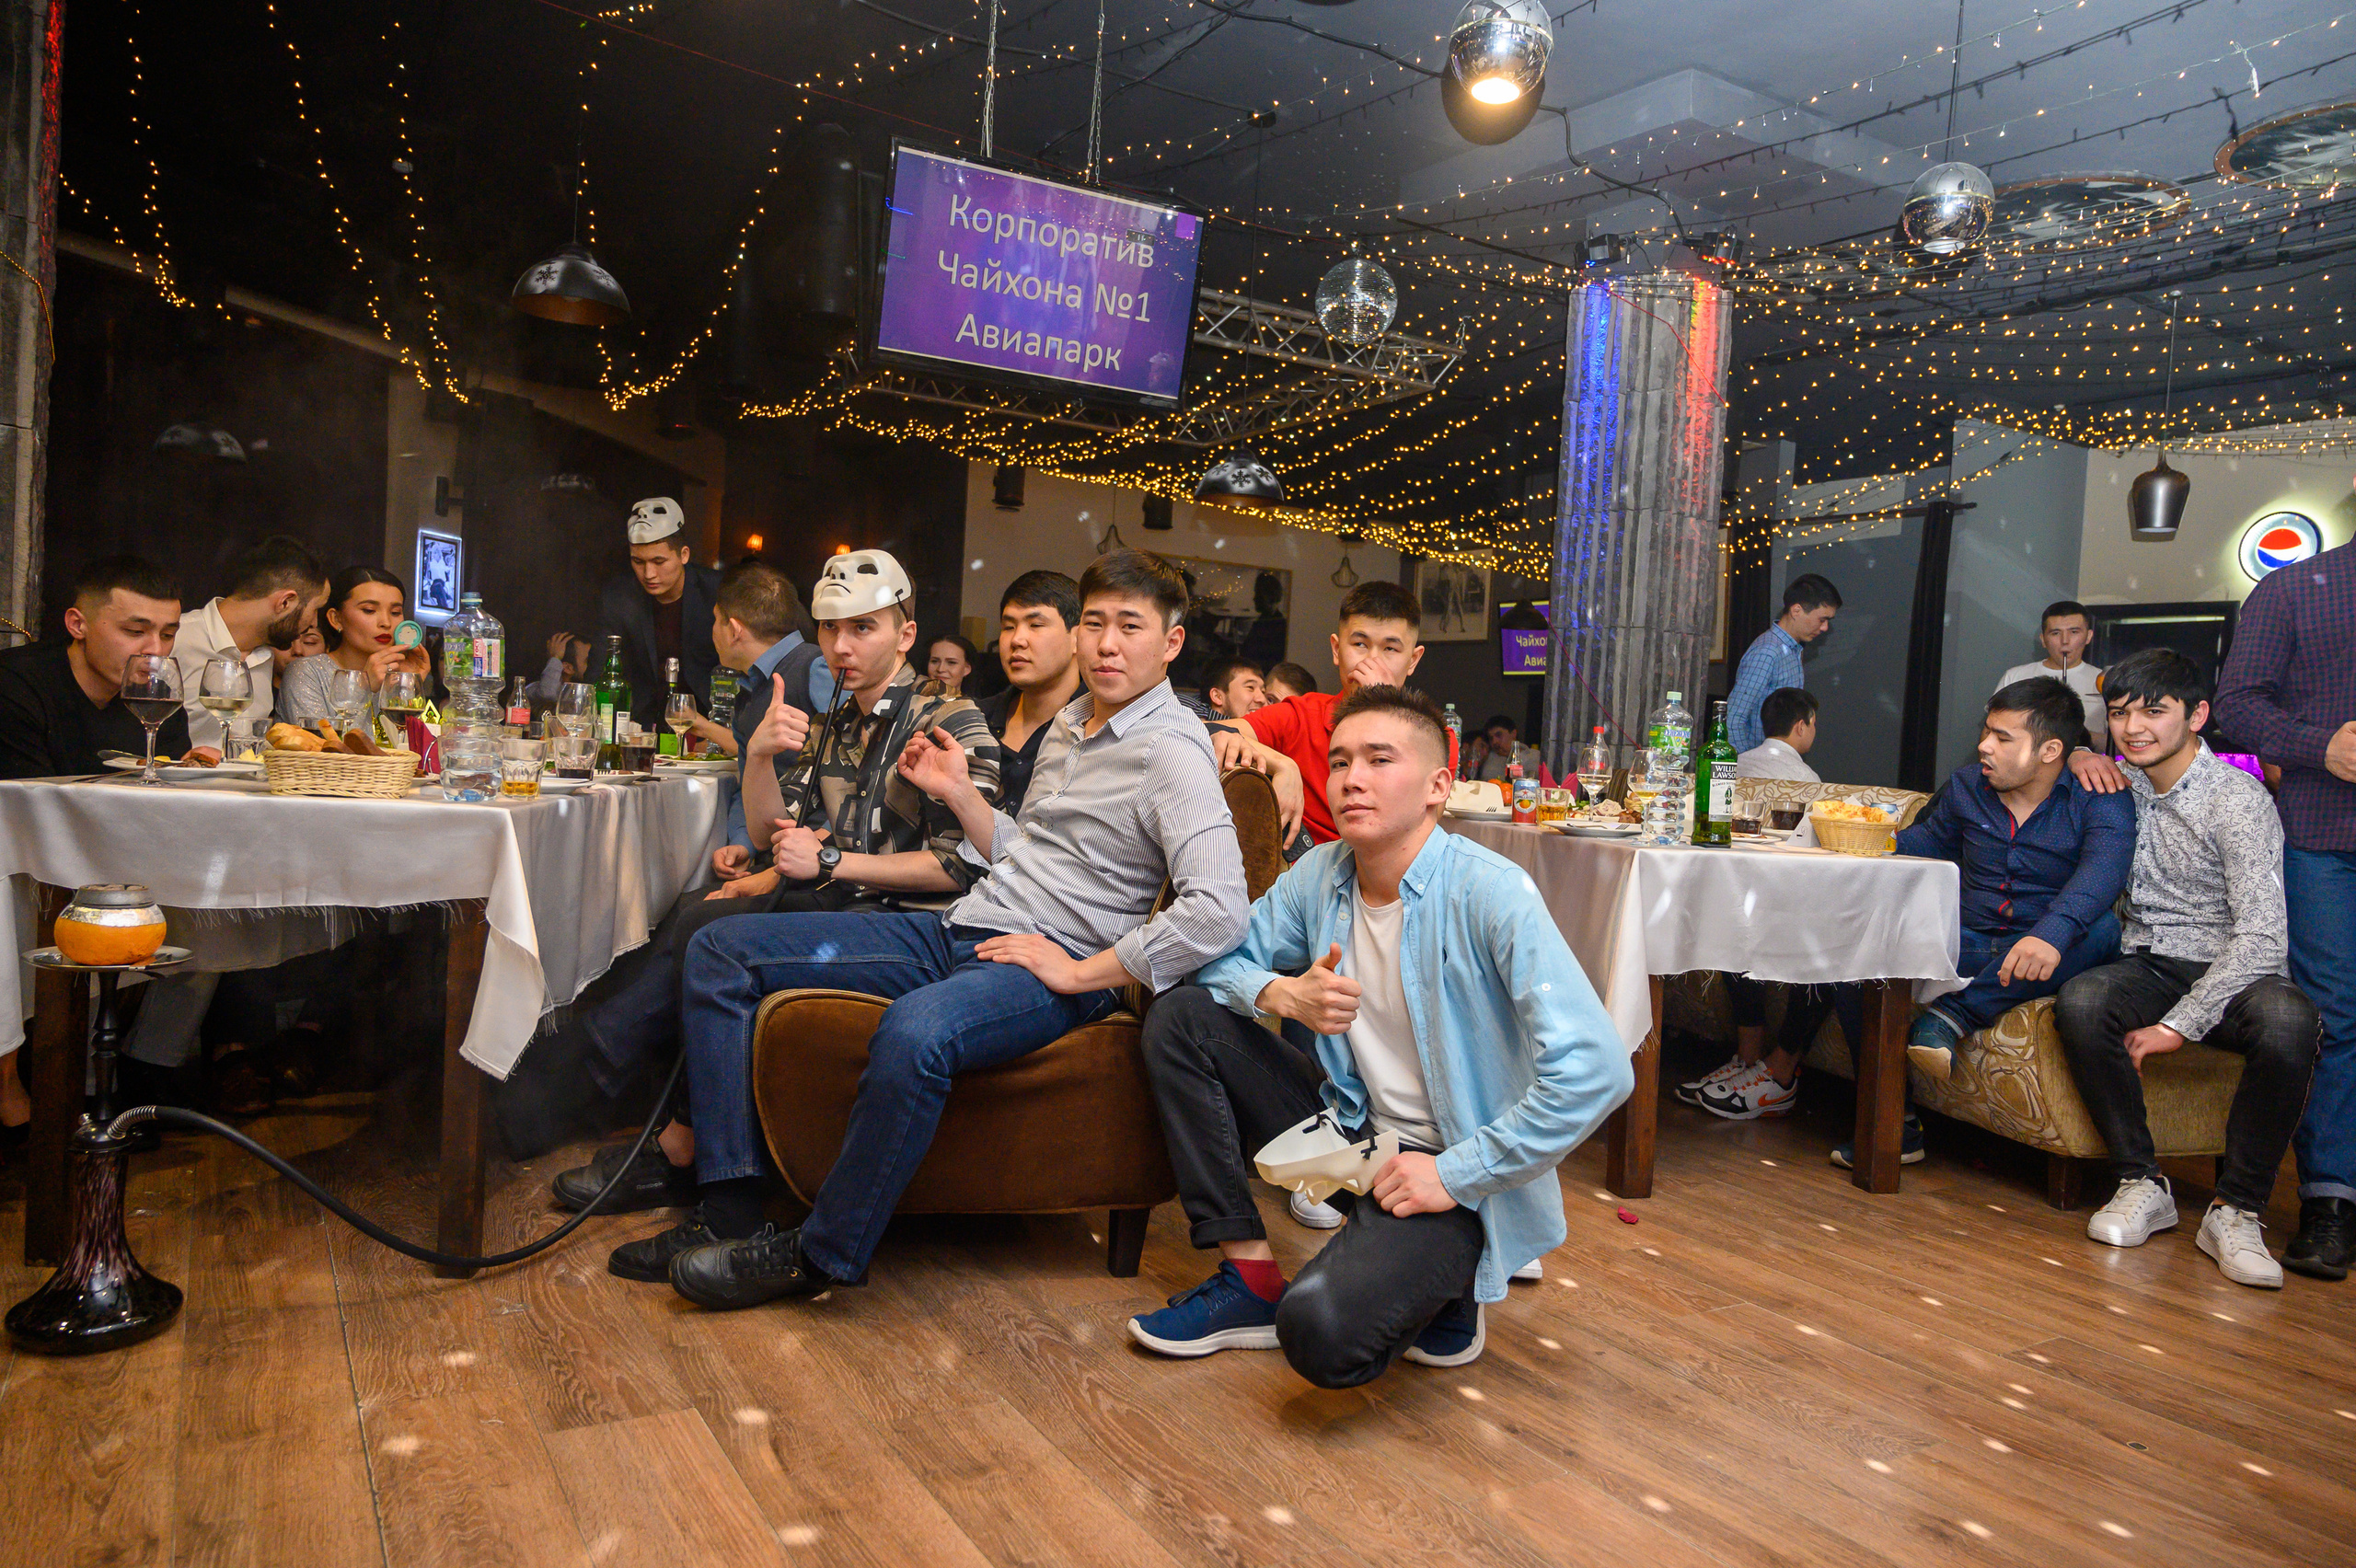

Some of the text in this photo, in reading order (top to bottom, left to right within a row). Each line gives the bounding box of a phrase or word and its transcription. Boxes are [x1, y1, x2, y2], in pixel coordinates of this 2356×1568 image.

[949, 193, 1154, 268] Корпоратив
[938, 249, 1151, 323] Чайхона №1
[954, 313, 1122, 373] Авиапарк
[1516, 634, 1547, 647] Чайхо
